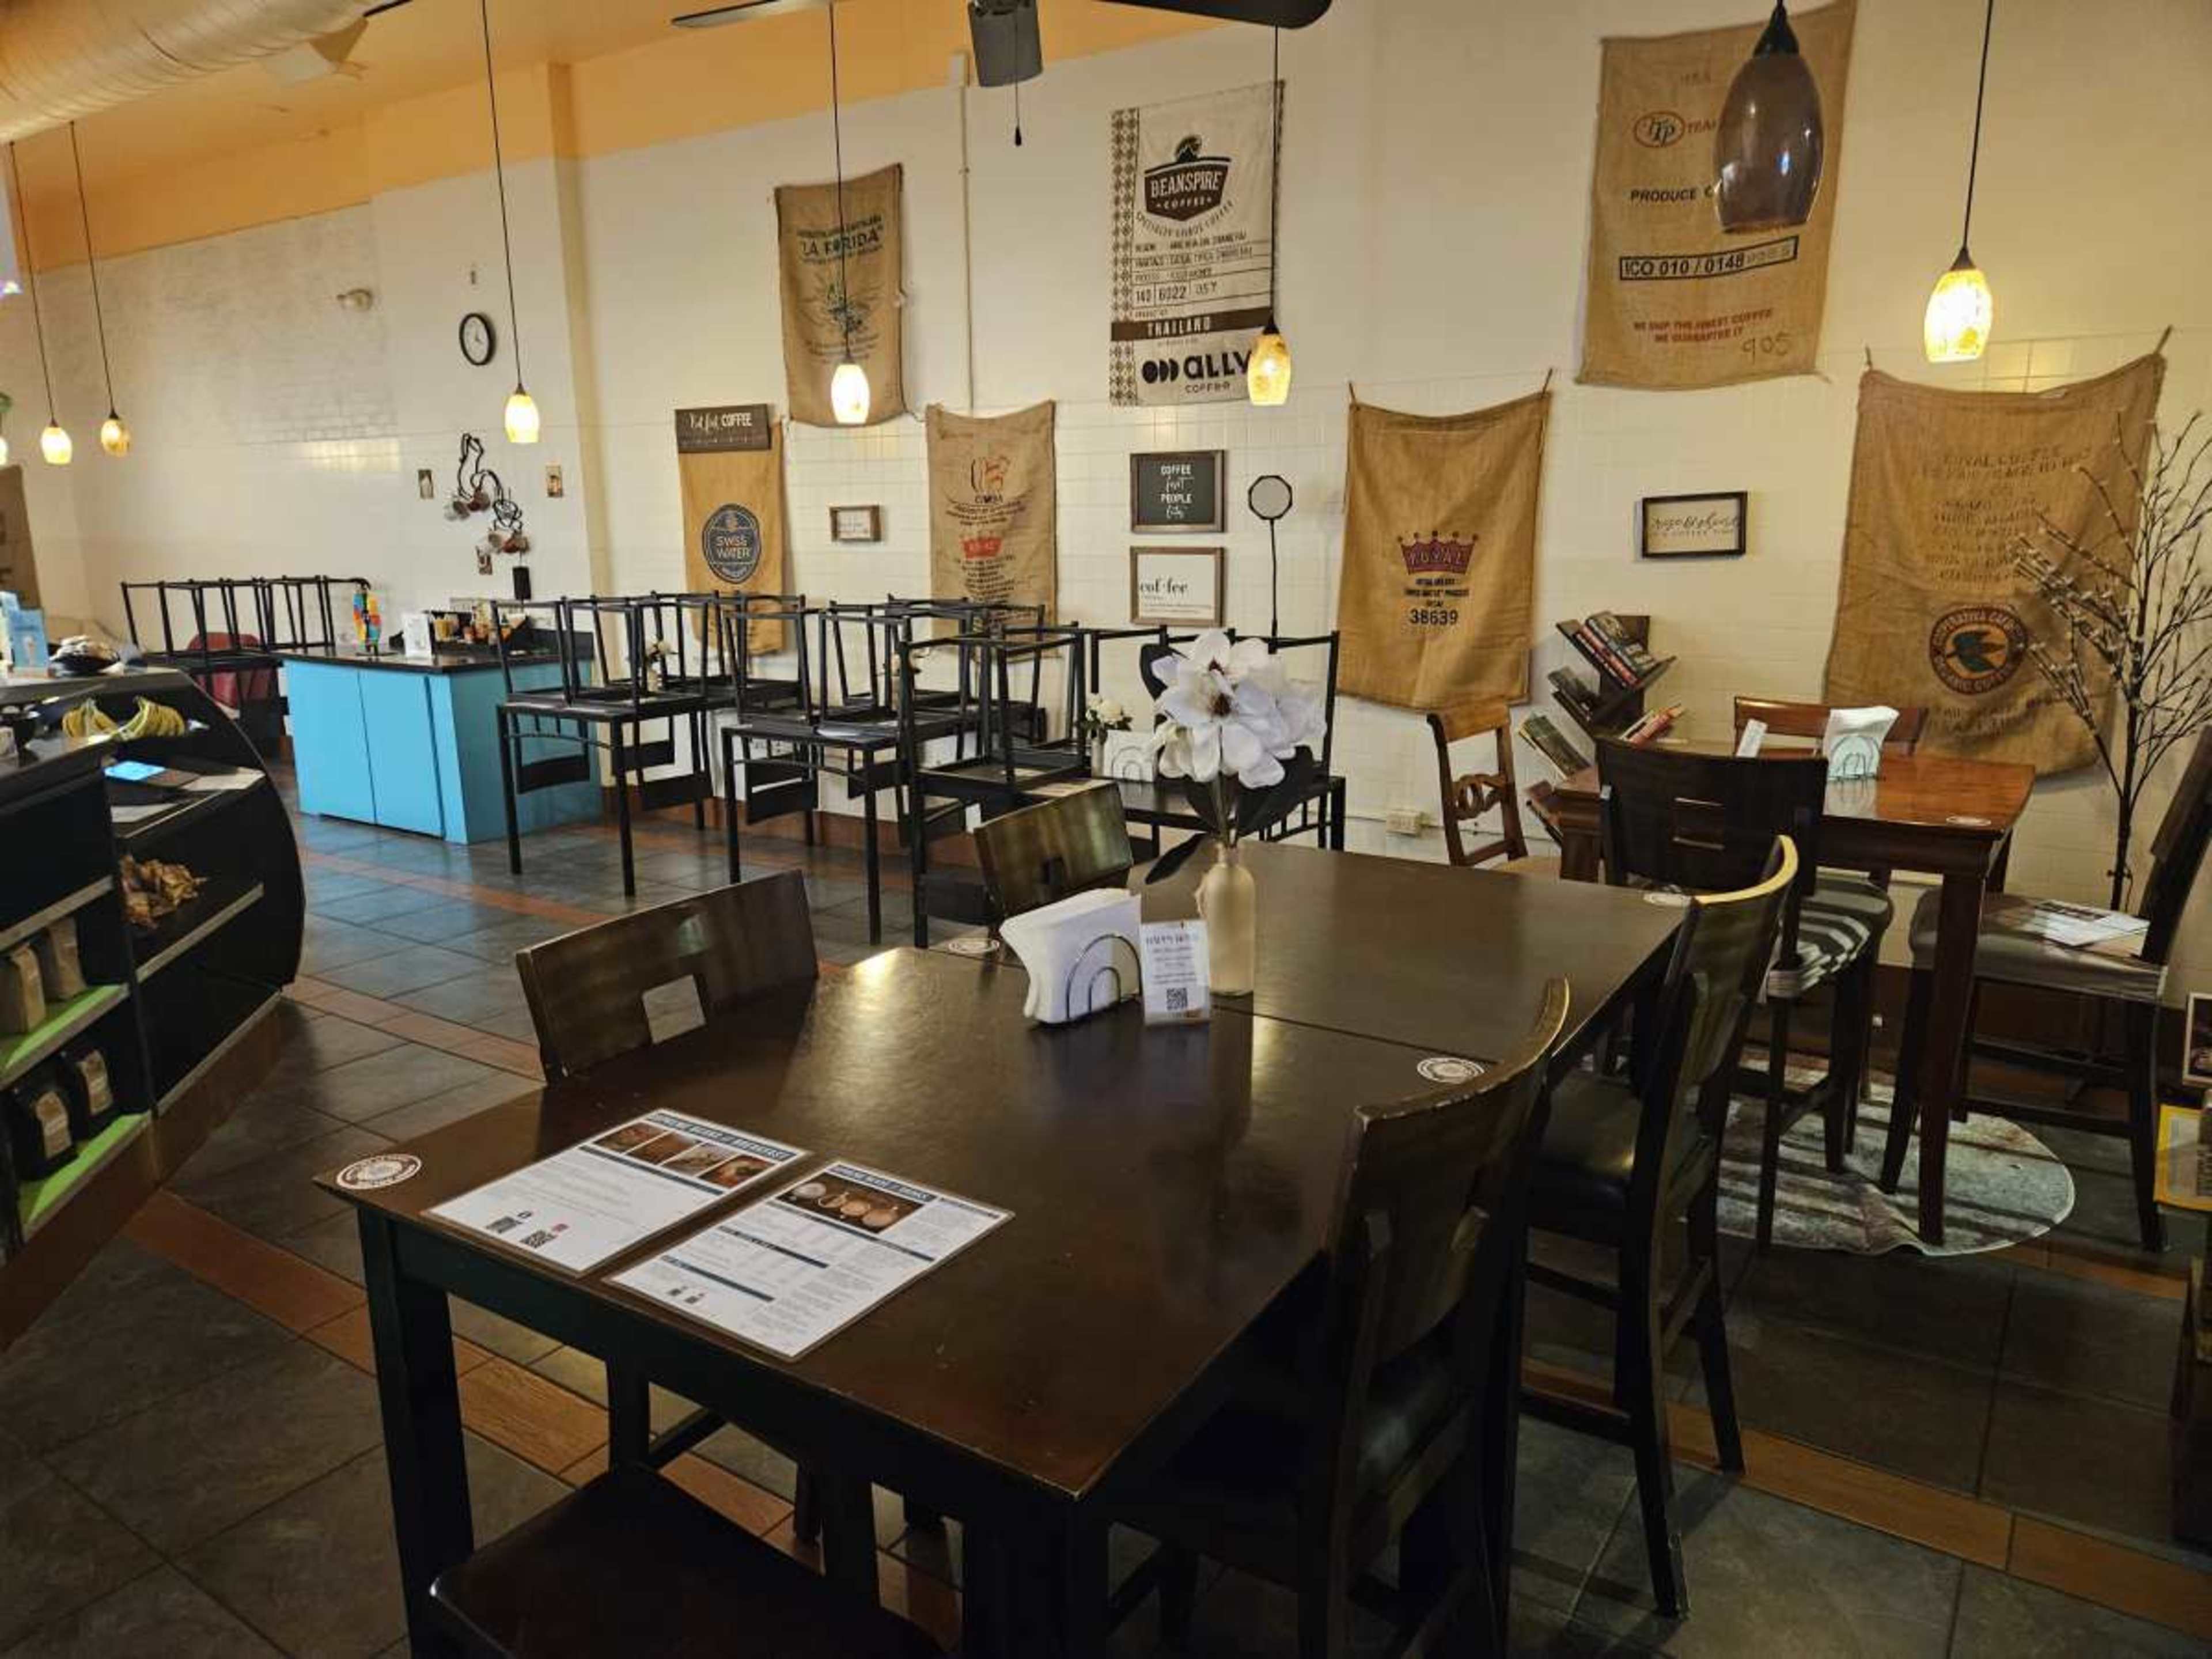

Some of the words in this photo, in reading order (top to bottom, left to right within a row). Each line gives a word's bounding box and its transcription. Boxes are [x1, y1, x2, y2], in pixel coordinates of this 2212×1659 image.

[1150, 170, 1223, 198] BEANSPIRE
[1630, 188, 1696, 203] PRODUCE
[1623, 259, 1654, 276] ICO
[1660, 259, 1689, 274] 010
[1705, 252, 1745, 272] 0148
[1147, 317, 1211, 337] THAILAND
[721, 412, 753, 427] COFFEE
[1161, 464, 1191, 475] COFFEE
[1161, 494, 1192, 503] PEOPLE
[716, 535, 747, 547] SWISS
[717, 547, 752, 558] WATER
[1410, 609, 1459, 625] 38639
